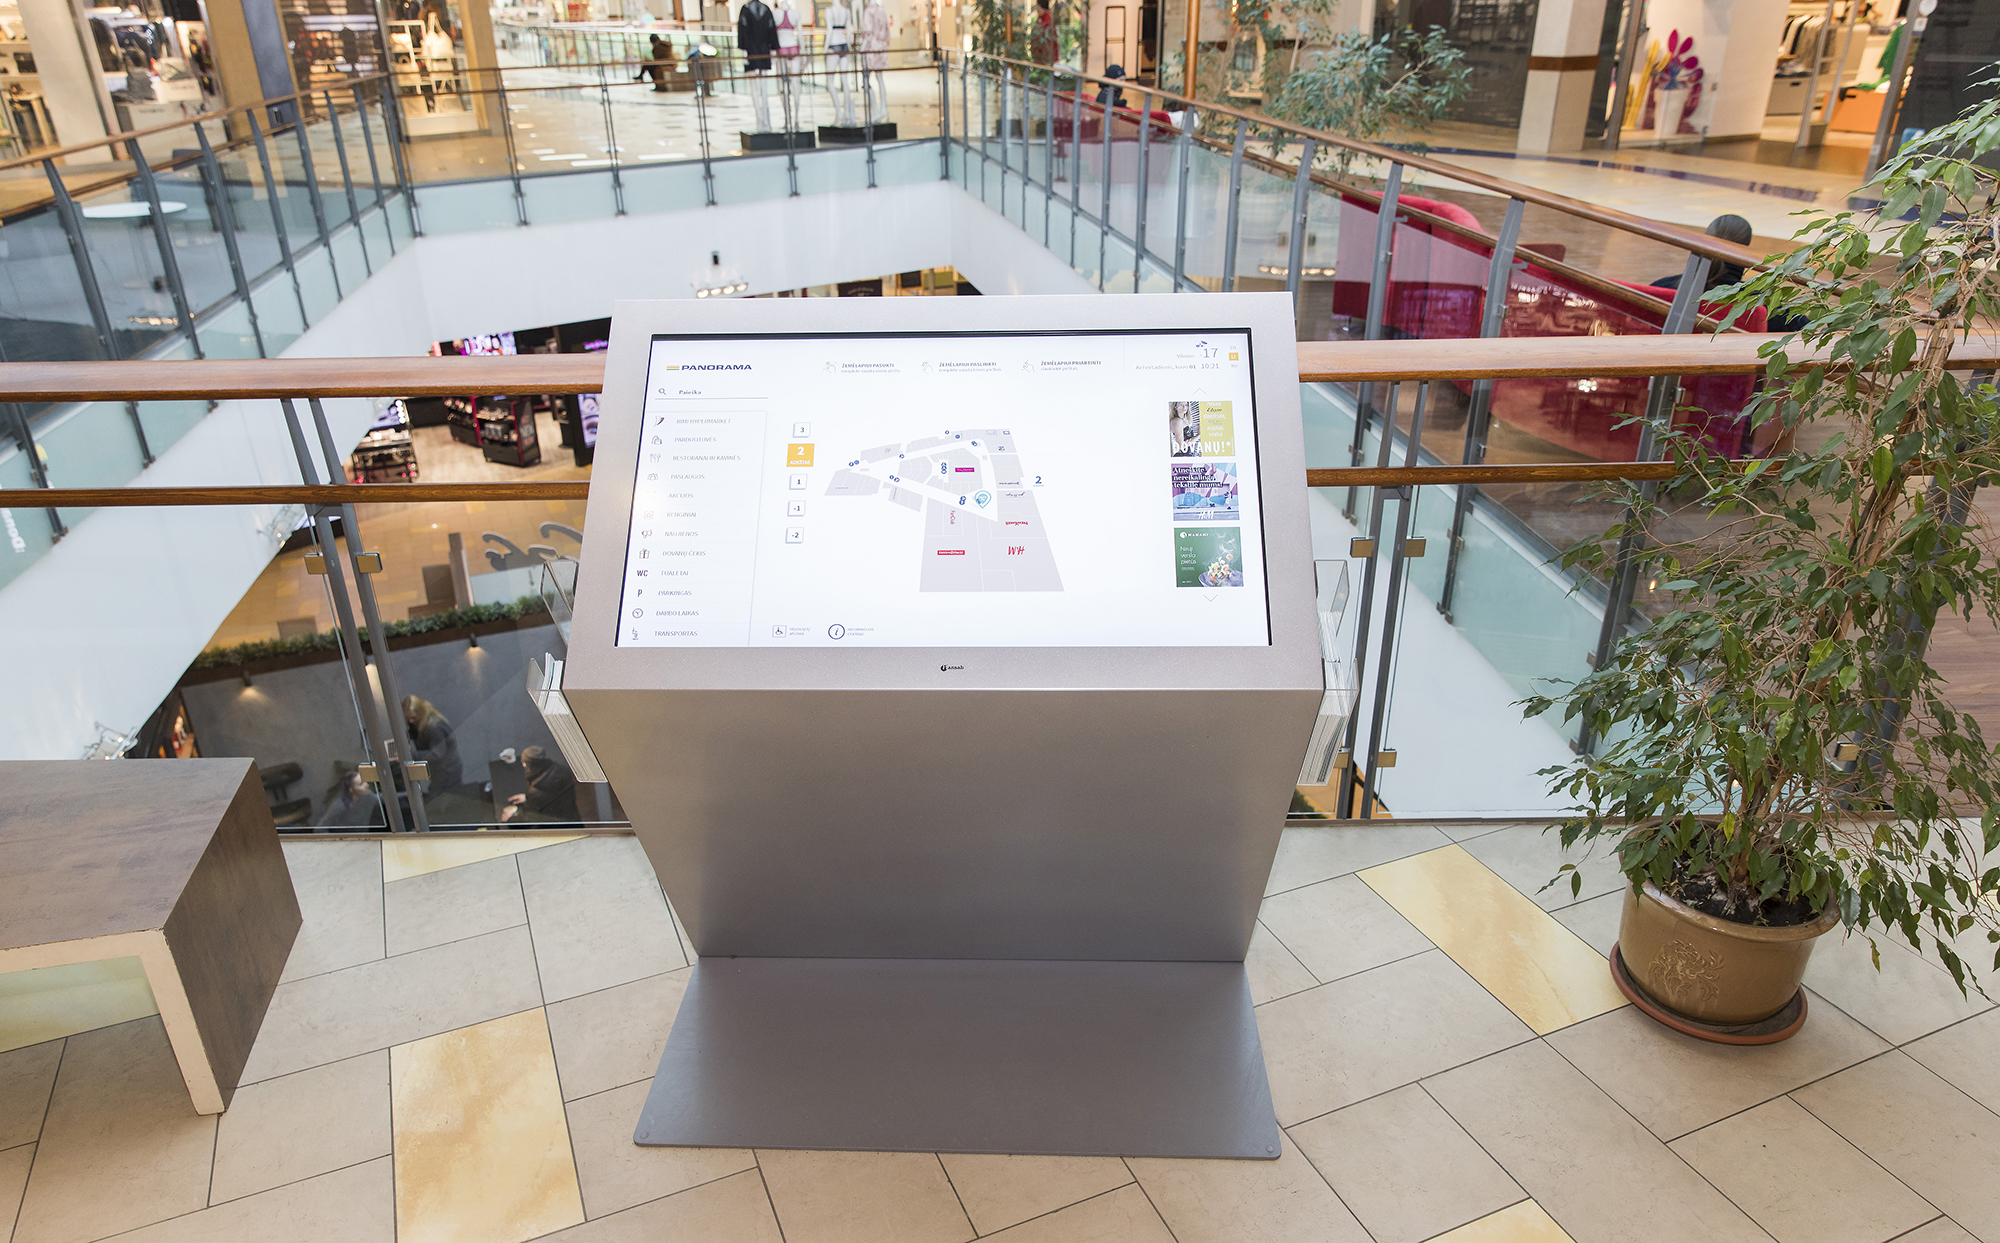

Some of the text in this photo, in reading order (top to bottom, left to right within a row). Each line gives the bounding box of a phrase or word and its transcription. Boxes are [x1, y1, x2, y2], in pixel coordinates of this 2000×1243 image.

[796, 446, 805, 456] 2
[1035, 475, 1042, 485] 2
[636, 569, 649, 577] WC
[637, 588, 643, 597] P
